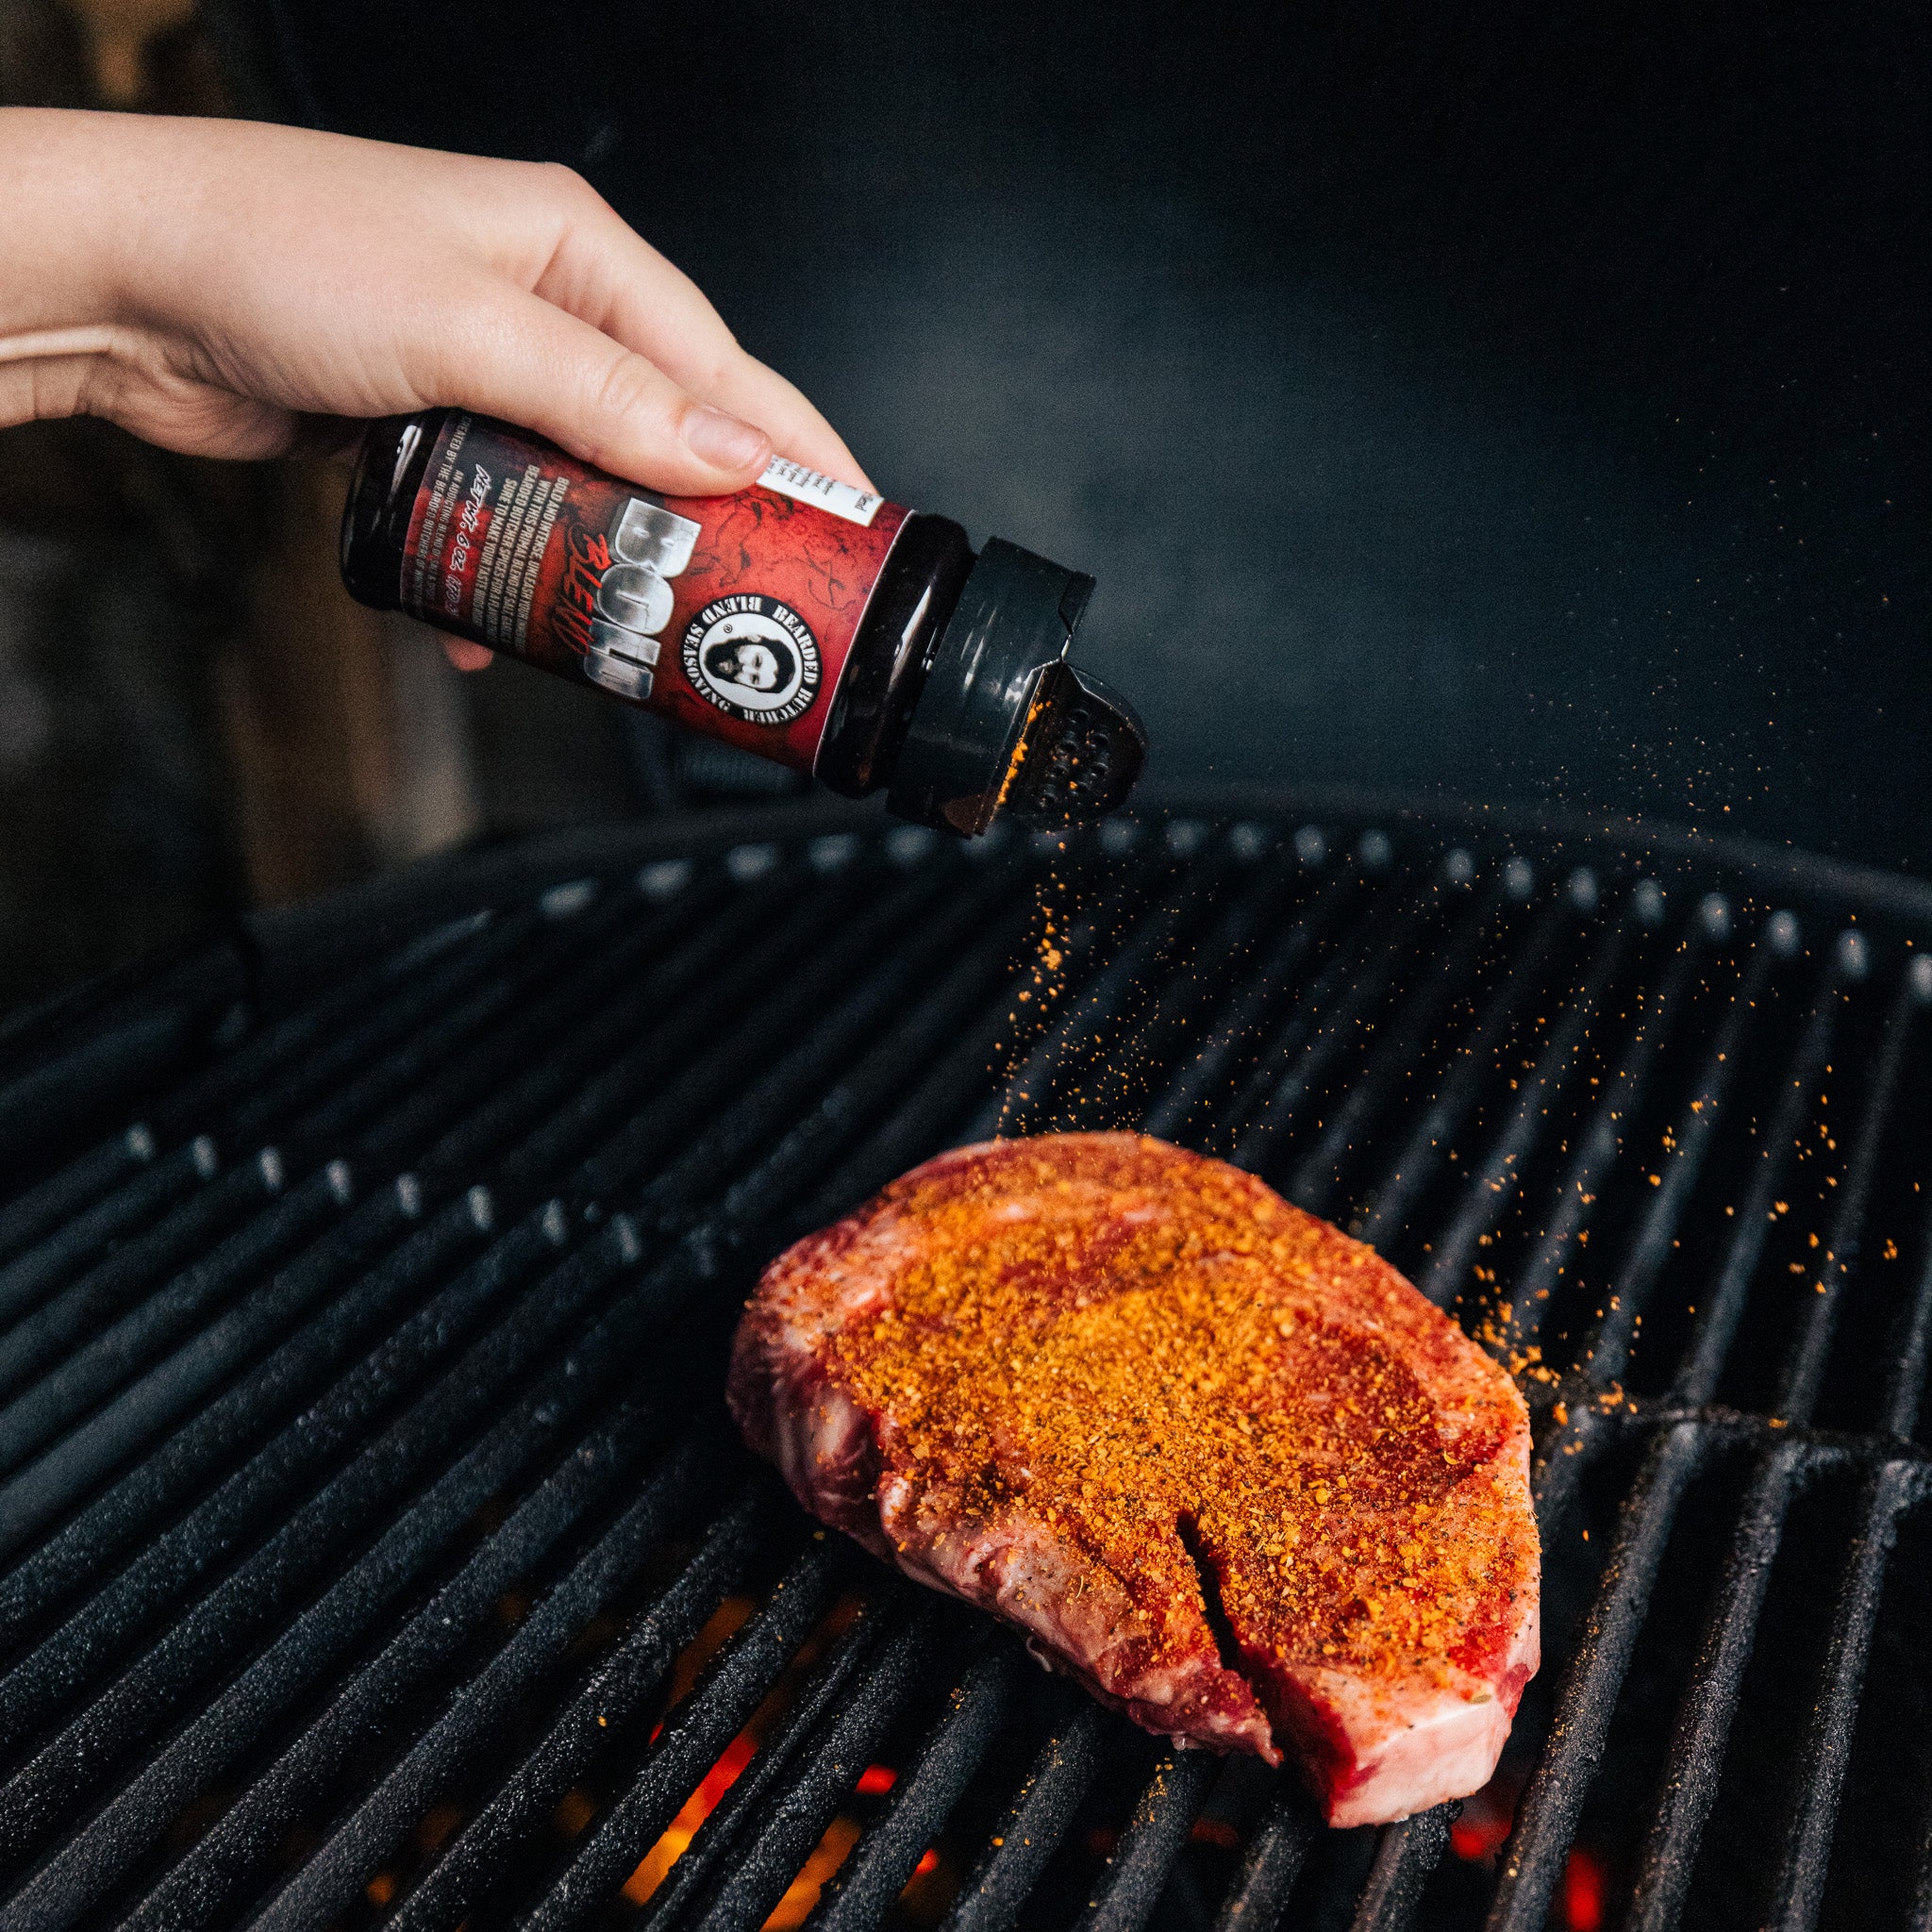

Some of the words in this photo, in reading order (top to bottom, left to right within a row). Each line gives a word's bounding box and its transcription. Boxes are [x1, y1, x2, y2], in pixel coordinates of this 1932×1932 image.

[444, 449, 457, 462] BY
[437, 462, 452, 480] THE
[452, 469, 463, 482] AN
[470, 464, 492, 508] NET
[498, 477, 517, 504] SURE
[514, 463, 539, 507] BEARDED
[531, 479, 551, 504] WITH
[549, 476, 569, 502] BOLD
[425, 479, 446, 519] BEARDED
[439, 481, 459, 523] ADDICTING
[494, 503, 508, 516] TO
[542, 499, 558, 522] AND
[458, 500, 477, 532] WT.
[486, 514, 504, 541] MAKE
[501, 505, 524, 547] BUTCHER
[524, 503, 541, 525] THIS
[417, 518, 434, 558] BUTCHERS
[433, 523, 446, 548] BLEND
[456, 530, 470, 549] 6
[513, 524, 534, 558] PRIMAL
[528, 520, 552, 559] INTENSE,
[449, 546, 466, 572] OZ.
[480, 541, 496, 565] YOUR
[492, 546, 510, 578] SPICES
[475, 564, 490, 590] TASTE
[490, 576, 503, 594] FOR
[508, 558, 524, 586] BLEND
[520, 559, 539, 600] UNLEASH
[505, 585, 517, 598] OF
[552, 527, 611, 656] BLEND
[584, 497, 702, 699] BOLD
[517, 598, 531, 620] YOUR
[702, 595, 762, 625] BLEND
[772, 605, 818, 684] BEARDED
[683, 623, 731, 711] SEASONING
[742, 688, 813, 723] BUTCHER
